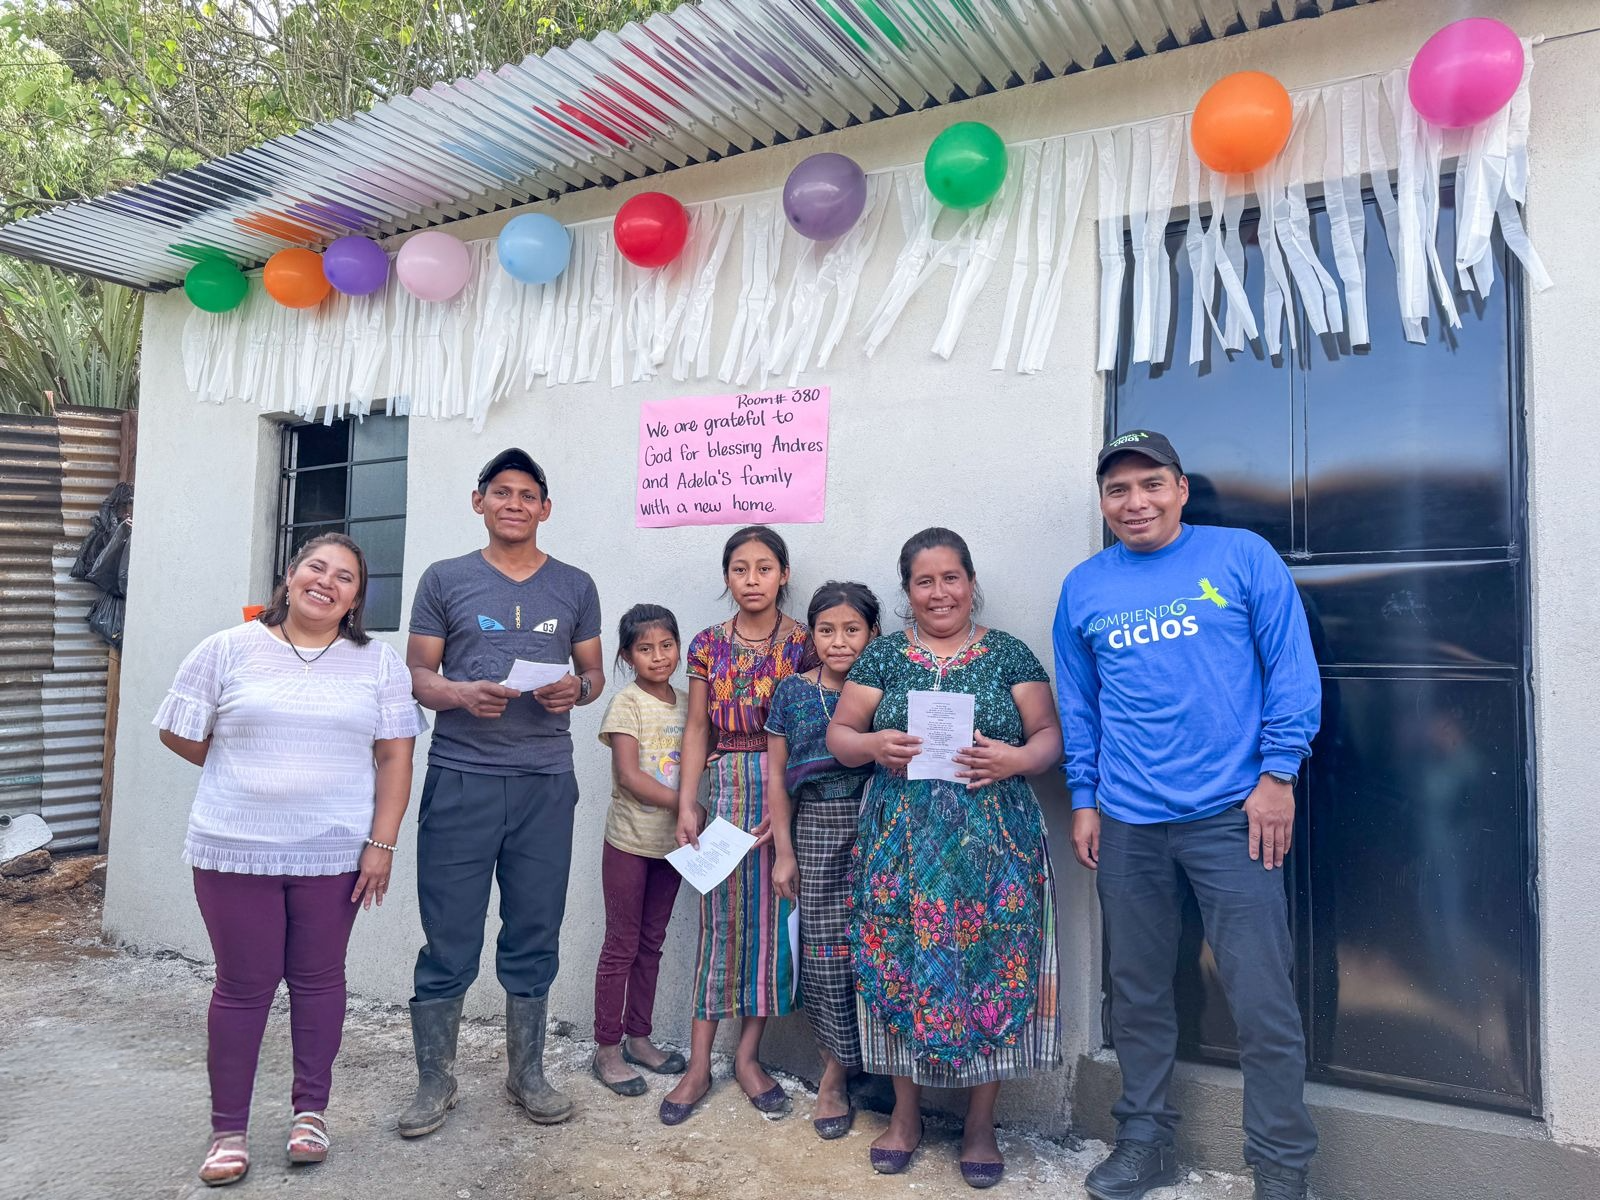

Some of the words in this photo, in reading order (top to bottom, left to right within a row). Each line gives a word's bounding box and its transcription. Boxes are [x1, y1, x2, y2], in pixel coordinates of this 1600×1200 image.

[792, 388, 820, 403] 380
[646, 421, 669, 438] We
[674, 419, 698, 432] are
[704, 410, 765, 436] grateful
[772, 410, 794, 425] to
[644, 446, 672, 466] God
[680, 443, 699, 461] for
[707, 441, 762, 459] blessing
[772, 435, 823, 453] Andres
[642, 473, 669, 490] and
[676, 469, 731, 490] Adela's
[740, 464, 793, 488] family
[640, 498, 669, 516] with
[677, 502, 688, 513] a
[694, 501, 722, 513] new
[732, 494, 777, 512] home.
[543, 623, 554, 632] 03
[1108, 615, 1199, 649] ciclos
